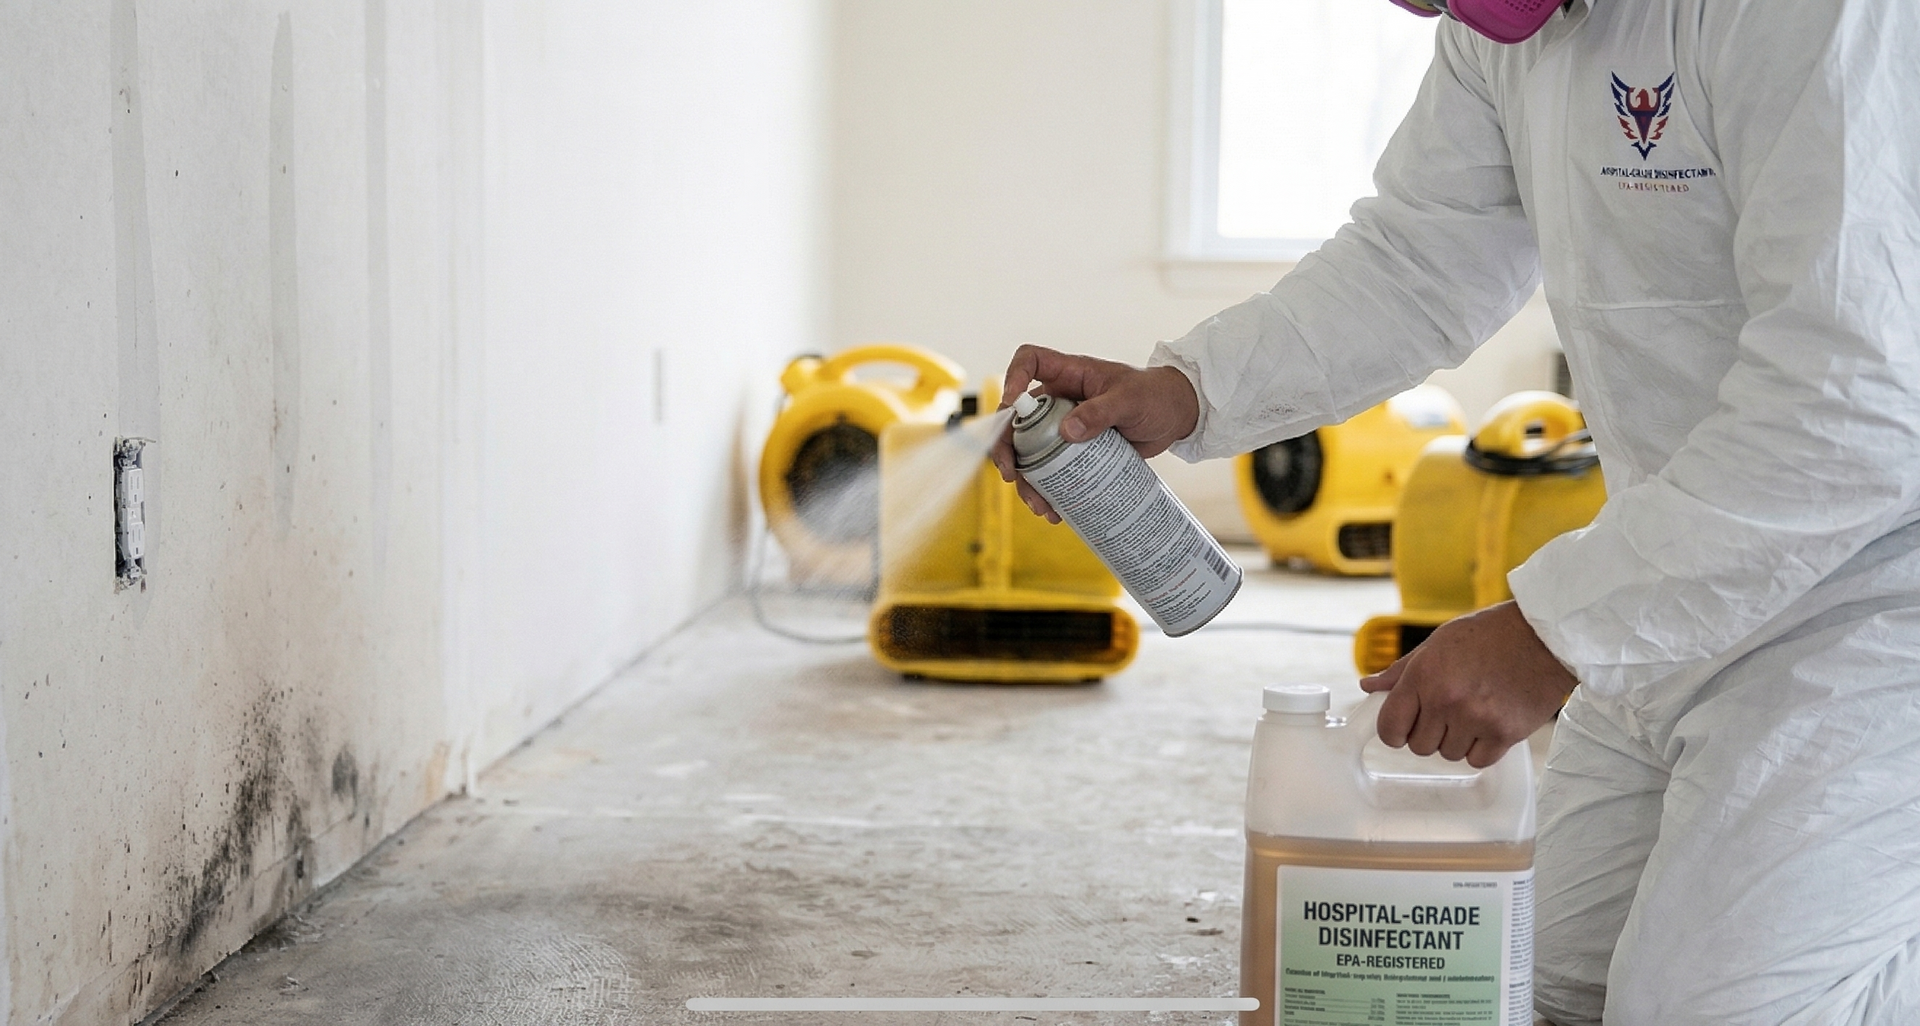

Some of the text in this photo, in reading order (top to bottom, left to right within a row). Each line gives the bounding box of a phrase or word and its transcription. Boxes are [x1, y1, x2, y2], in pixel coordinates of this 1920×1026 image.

[1303, 901, 1480, 925] HOSPITAL-GRADE
[1318, 927, 1464, 950] DISINFECTANT
[1336, 953, 1446, 970] EPA-REGISTERED
